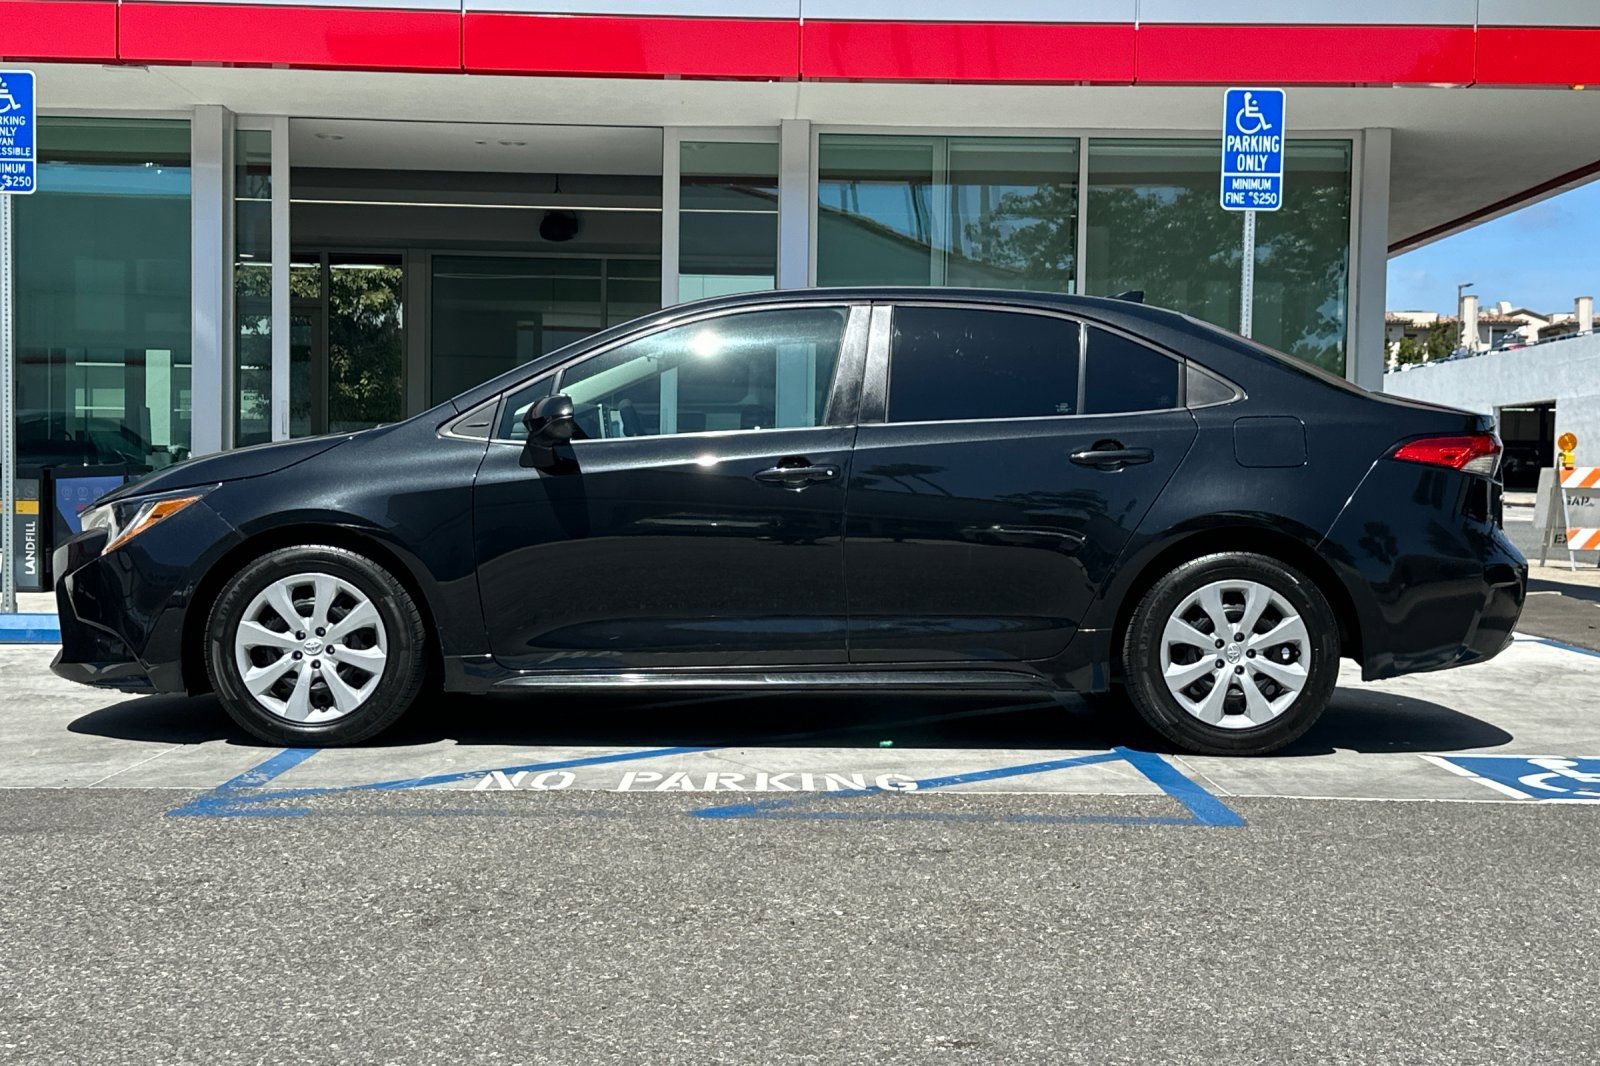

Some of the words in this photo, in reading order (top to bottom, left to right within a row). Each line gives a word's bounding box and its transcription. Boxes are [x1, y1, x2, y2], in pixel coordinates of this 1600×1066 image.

[1226, 135, 1280, 153] PARKING
[1237, 154, 1268, 171] ONLY
[1232, 178, 1271, 190] MINIMUM
[1225, 192, 1245, 204] FINE
[1253, 193, 1277, 205] $250
[25, 521, 36, 575] LANDFILL
[473, 770, 576, 791] NO
[616, 771, 918, 791] PARKING
